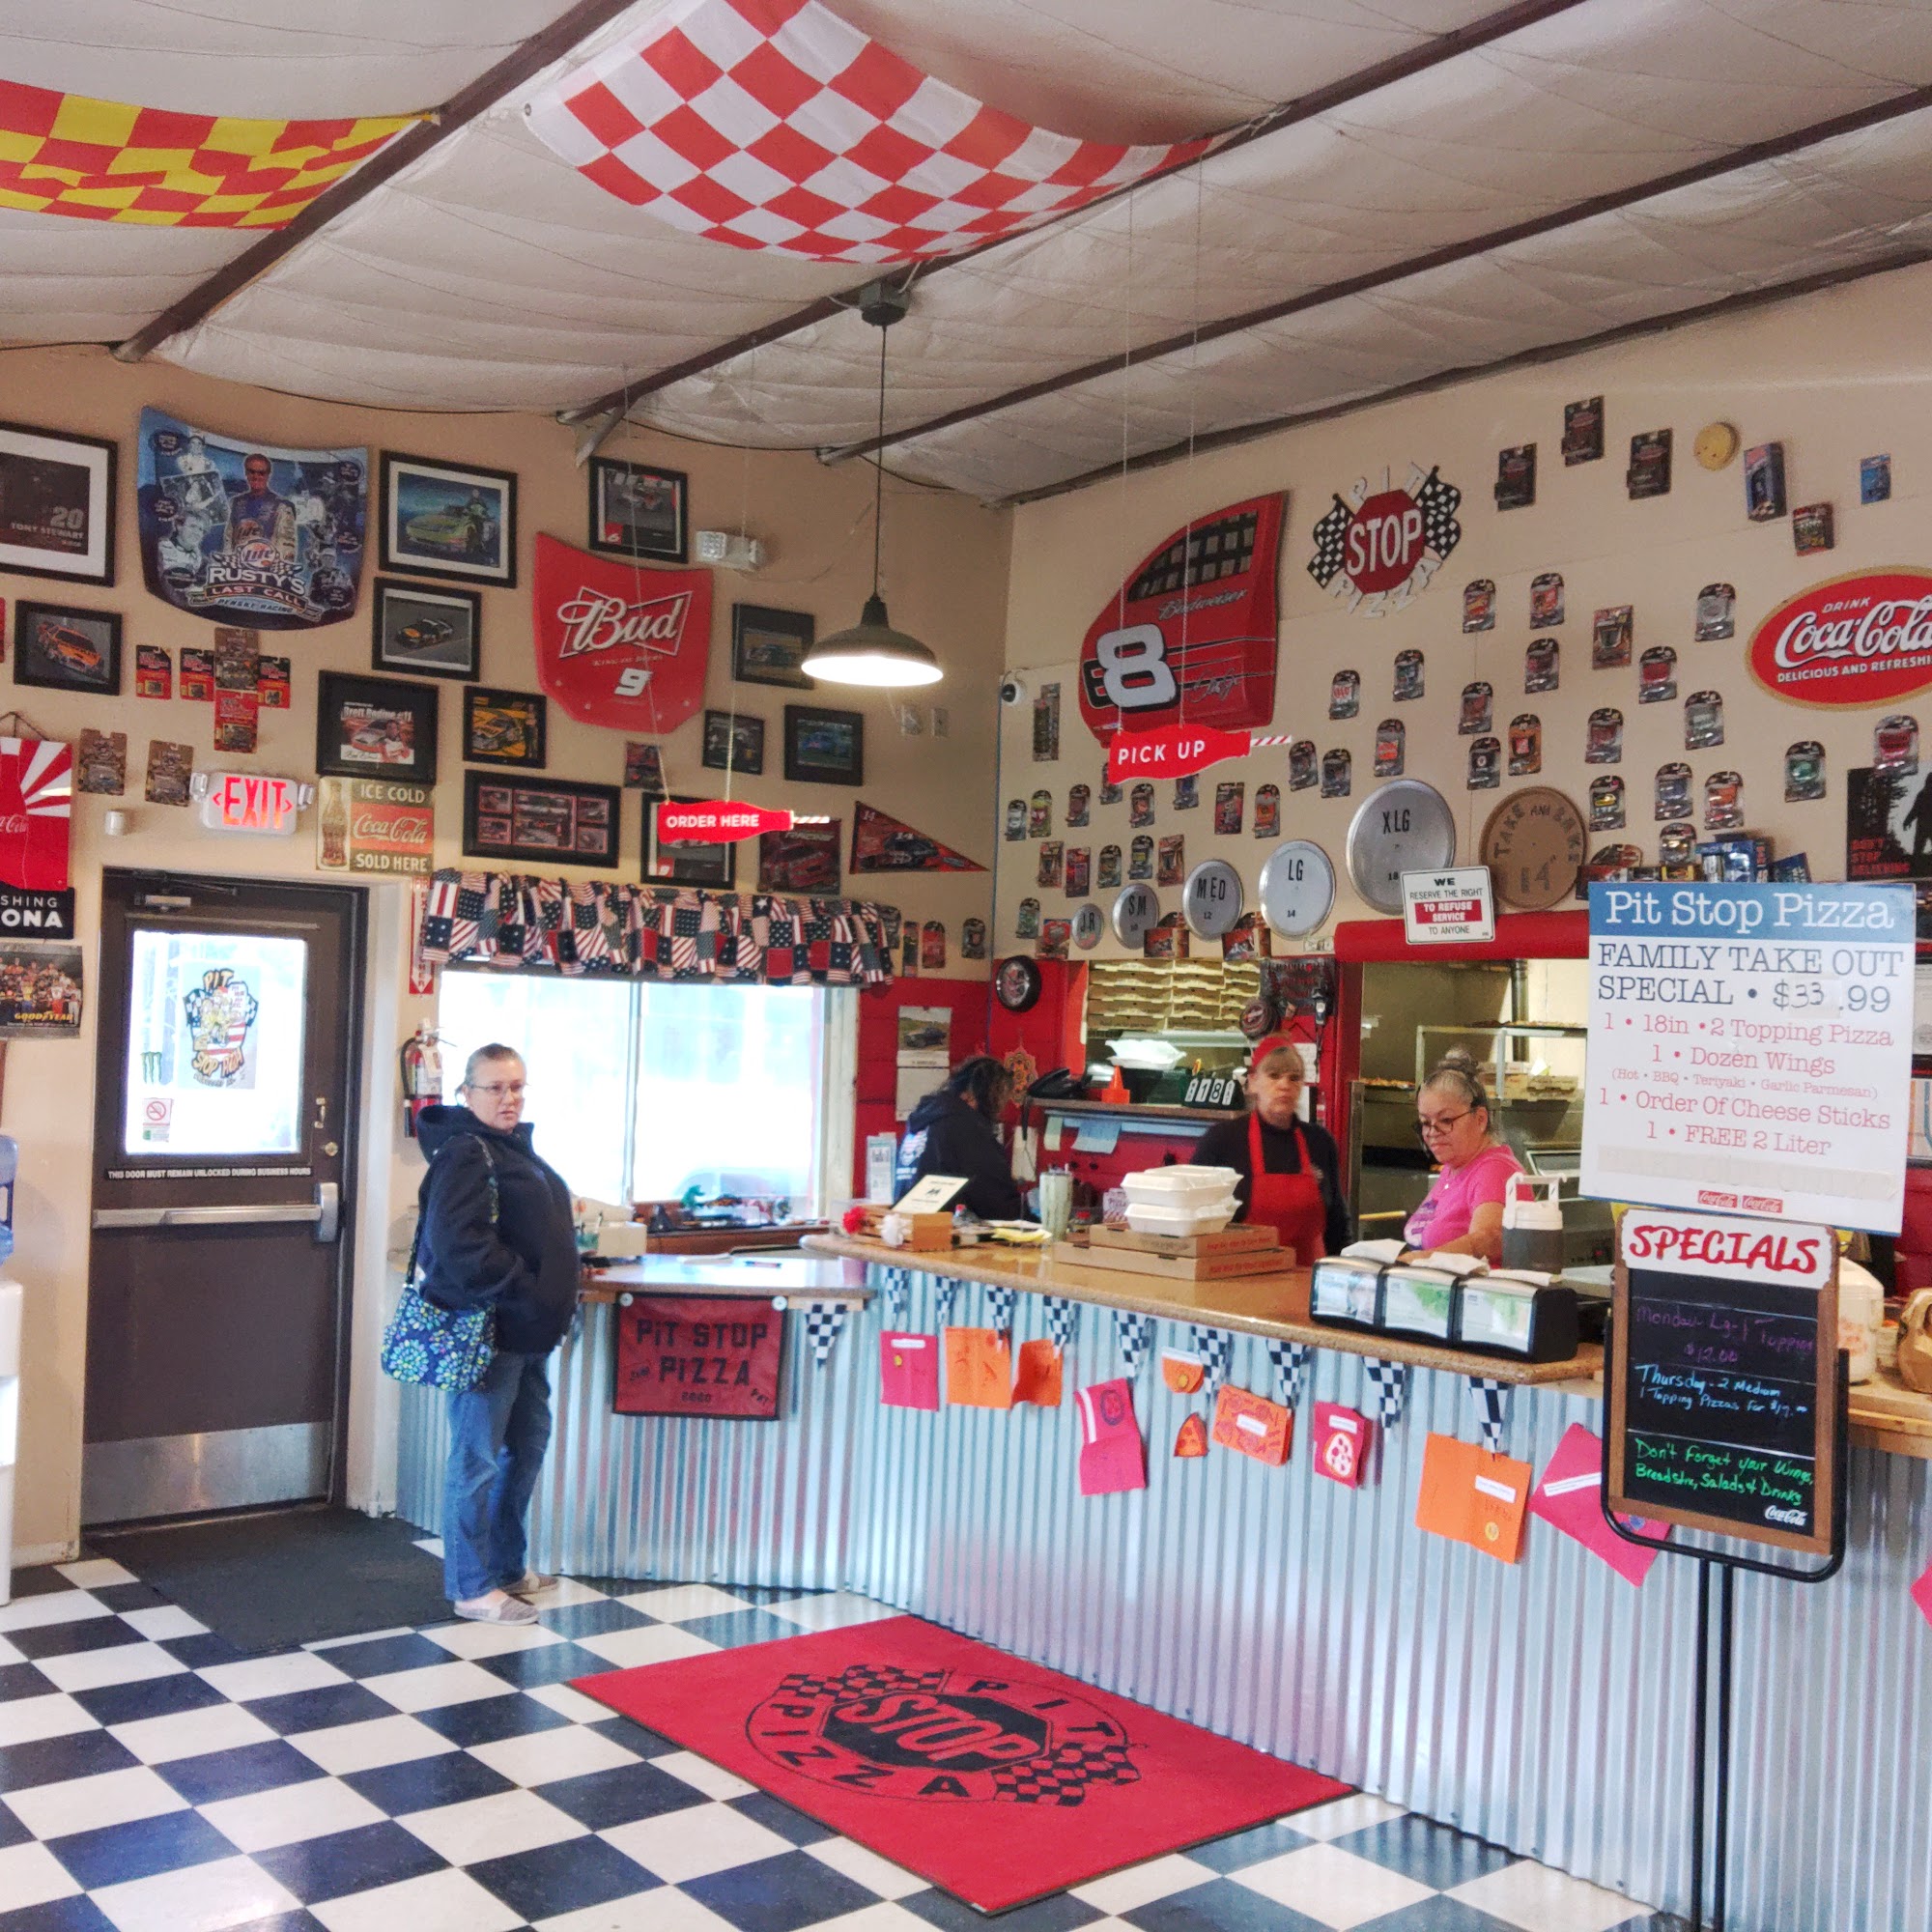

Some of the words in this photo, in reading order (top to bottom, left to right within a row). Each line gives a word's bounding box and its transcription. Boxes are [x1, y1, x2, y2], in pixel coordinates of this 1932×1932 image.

[50, 506, 84, 529] 20
[11, 523, 38, 532] TONY
[41, 526, 84, 539] STEWART
[1347, 509, 1422, 576] STOP
[209, 567, 306, 595] RUSTY'S
[212, 585, 255, 595] LAST
[263, 587, 302, 607] CALL
[1158, 588, 1248, 620] Budweiser
[1822, 596, 1871, 613] DRINK
[557, 598, 685, 651] Bud
[1775, 593, 1932, 668] Coca-Cola
[1096, 623, 1178, 708] 8
[1777, 666, 1839, 683] DELICIOUS
[1841, 663, 1868, 675] AND
[614, 668, 653, 696] 9
[1118, 742, 1166, 765] PICK
[1178, 739, 1206, 759] UP
[221, 776, 286, 829] EXIT
[360, 783, 384, 800] ICE
[387, 786, 425, 804] COLD
[354, 812, 428, 843] Coca-Cola
[666, 814, 716, 828] ORDER
[720, 813, 760, 828] HERE
[1382, 809, 1410, 835] XLG
[1493, 803, 1525, 859] TAKE
[355, 853, 389, 869] SOLD
[393, 856, 428, 871] HERE
[1288, 859, 1303, 881] LG
[1387, 871, 1399, 881] 18
[1434, 877, 1455, 886] WE
[0, 895, 58, 908] SHING
[1196, 877, 1226, 901] MED
[1409, 890, 1441, 899] RESERVE
[1444, 889, 1458, 897] THE
[1461, 888, 1483, 896] RIGHT
[1, 908, 64, 928] ONA
[1128, 895, 1147, 917] SM
[1287, 909, 1296, 918] 14
[1424, 903, 1435, 913] TO
[1437, 901, 1472, 911] REFUSE
[1433, 912, 1465, 923] SERVICE
[1605, 892, 1662, 924] Pit
[1672, 892, 1764, 934] Stop
[1774, 893, 1894, 929] Pizza
[1428, 926, 1438, 935] TO
[1440, 924, 1469, 935] ANYONE
[1598, 943, 1721, 971] FAMILY
[1728, 947, 1822, 974] TAKE
[1832, 950, 1904, 978] OUT
[203, 968, 234, 992] PIT
[1598, 976, 1734, 1005] SPECIAL
[14, 1011, 73, 1022] GOODYEAR
[1604, 1012, 1614, 1031] 1
[1643, 1014, 1690, 1035] 18in
[1710, 1018, 1724, 1037] 2
[1730, 1018, 1823, 1046] Topping
[1829, 1024, 1894, 1047] Pizza
[1652, 1044, 1662, 1063] 1
[1690, 1047, 1759, 1069] Dozen
[1766, 1052, 1835, 1078] Wings
[1611, 1067, 1639, 1082] (Hot
[1653, 1071, 1679, 1085] BBQ
[1693, 1074, 1746, 1090] Teriyaki
[1761, 1079, 1800, 1093] Garlic
[1803, 1082, 1879, 1100] Parmesan)
[1599, 1088, 1608, 1106] 1
[1635, 1091, 1698, 1112] Order
[1703, 1095, 1727, 1117] Of
[1731, 1098, 1811, 1122] Cheese
[1817, 1105, 1890, 1130] Sticks
[1646, 1121, 1658, 1140] 1
[1684, 1123, 1747, 1148] FREE
[1753, 1130, 1768, 1150] 2
[1774, 1132, 1833, 1156] Liter
[126, 1170, 145, 1179] DOOR
[167, 1169, 193, 1178] REMAIN
[194, 1169, 231, 1178] UNLOCKED
[232, 1168, 256, 1177] DURING
[257, 1167, 288, 1177] BUSINESS
[289, 1167, 311, 1176] HOURS
[1628, 1225, 1821, 1274] SPECIALS
[693, 1321, 768, 1350] STOP
[1647, 1386, 1692, 1409] Topping
[1734, 1380, 1780, 1397] Medium
[1634, 1438, 1677, 1460] Don't
[1739, 1458, 1767, 1476] your
[1760, 1476, 1803, 1506] Drinks
[1764, 1505, 1807, 1526] Coca-Cola
[966, 1679, 1117, 1738] PIT
[834, 1693, 1039, 1764] STOP
